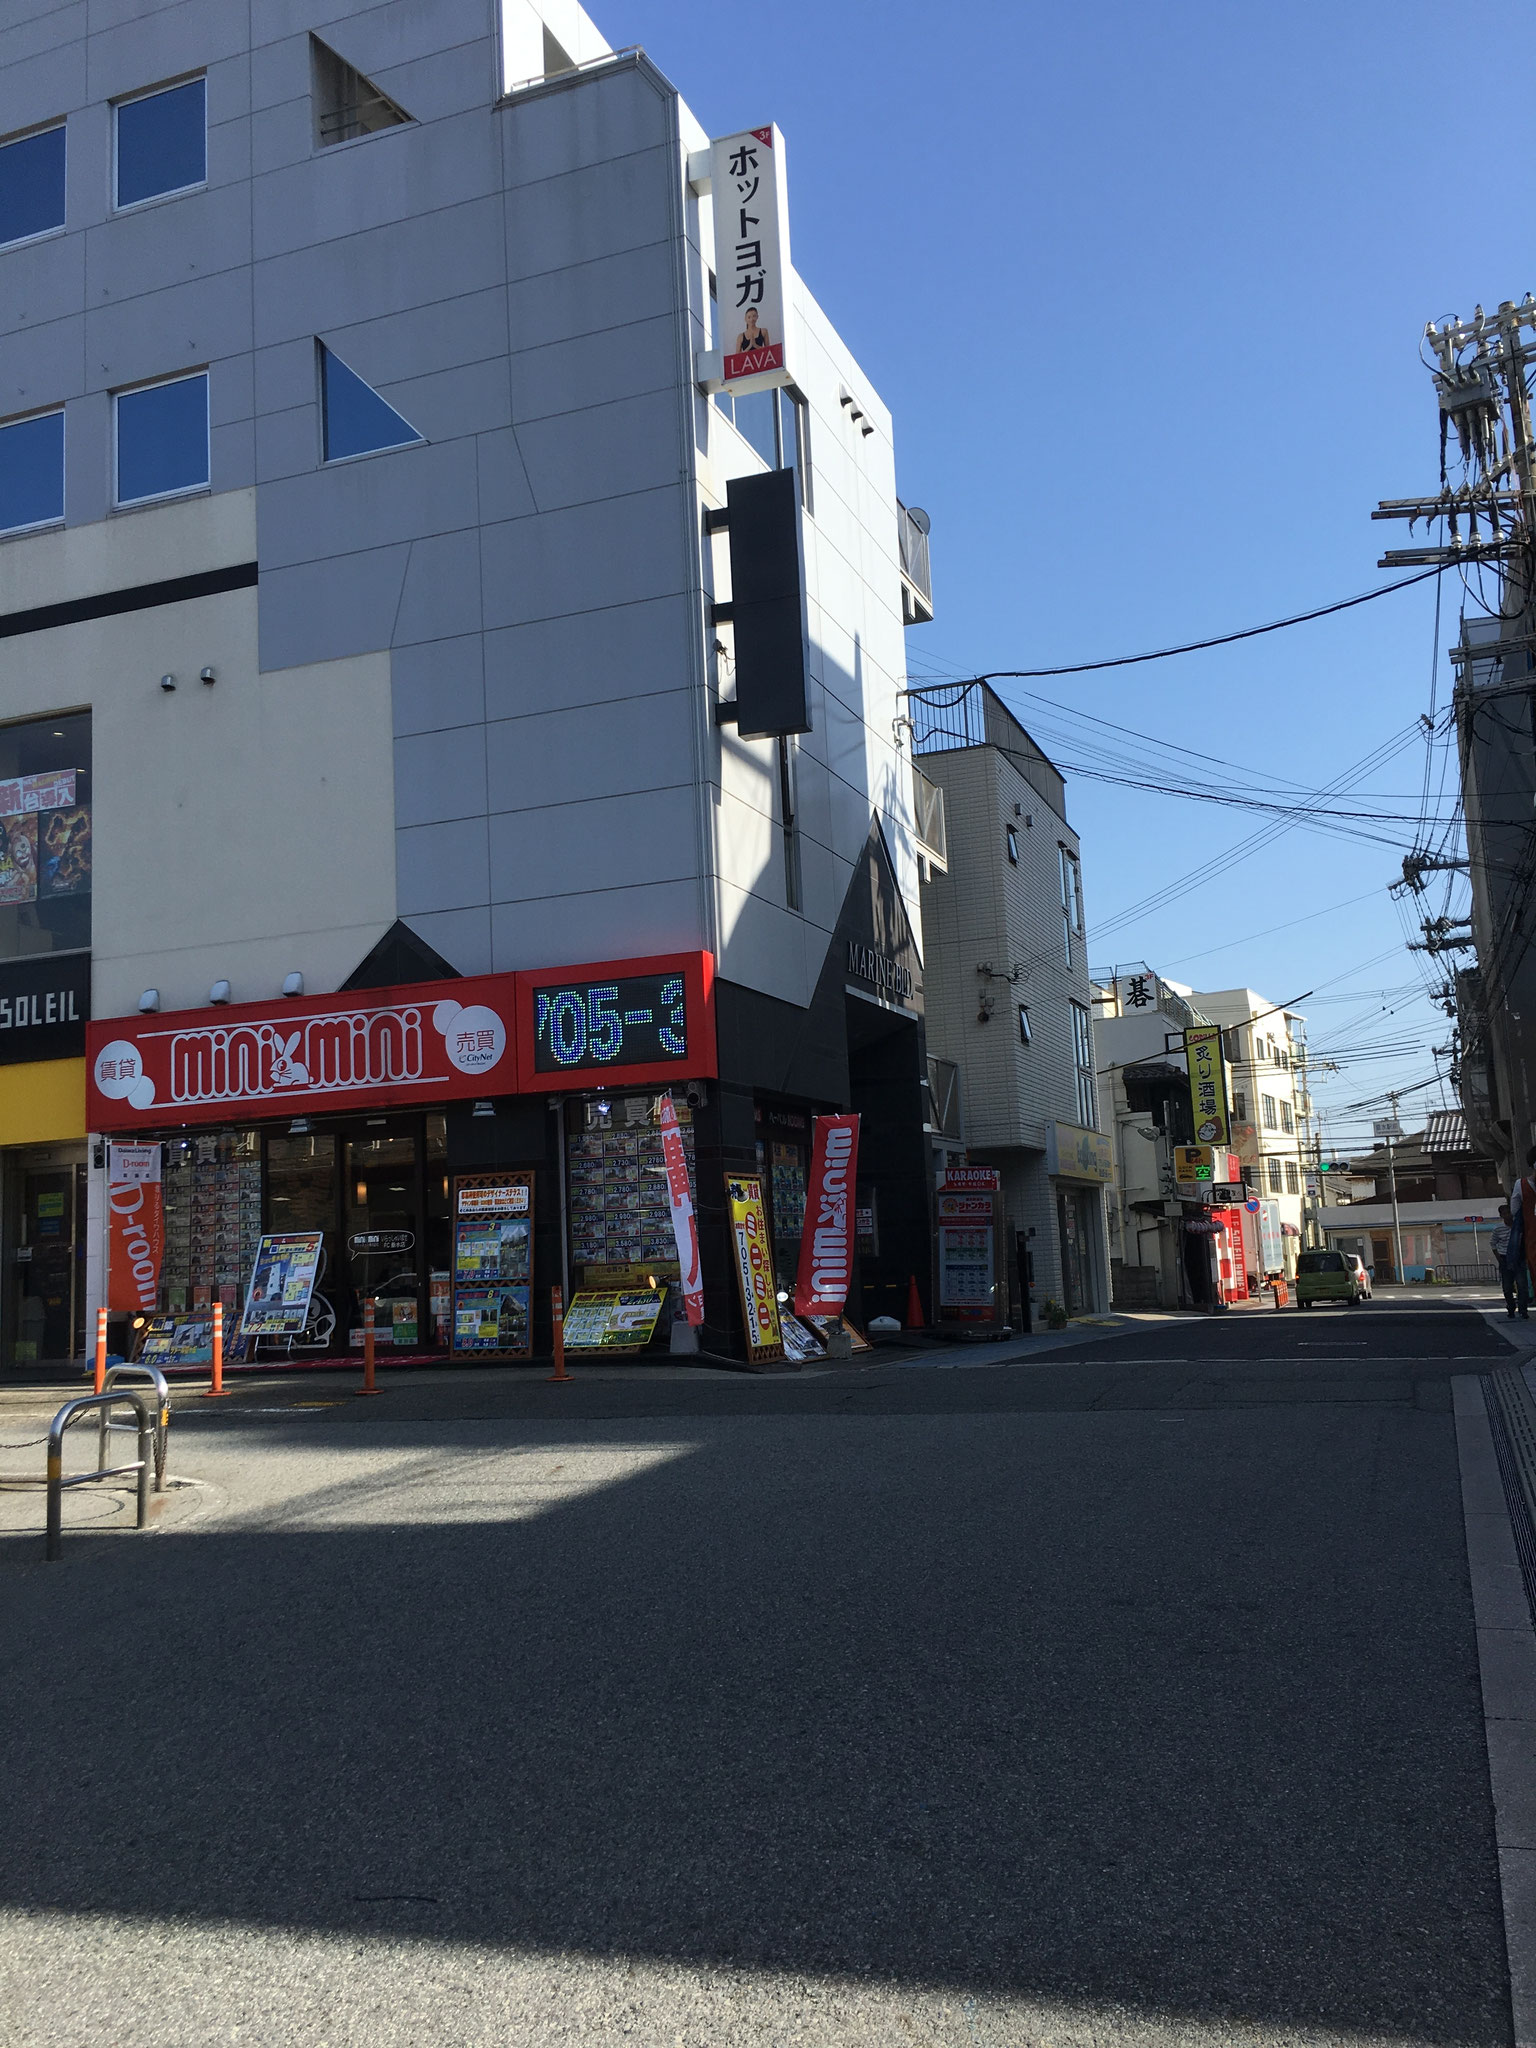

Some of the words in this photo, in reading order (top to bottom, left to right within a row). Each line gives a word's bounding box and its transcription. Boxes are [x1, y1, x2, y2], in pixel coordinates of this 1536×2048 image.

[760, 130, 770, 140] 3F
[729, 145, 767, 308] ホットヨガ
[731, 350, 777, 375] LAVA
[848, 941, 892, 990] MARINE
[1125, 976, 1154, 1008] 碁
[0, 990, 79, 1029] SOLEIL
[457, 1030, 494, 1053] 売買
[171, 1025, 275, 1102] mini
[305, 1008, 423, 1089] mini
[467, 1054, 492, 1062] CityNet
[100, 1059, 136, 1081] 賃貸
[1195, 1045, 1217, 1115] 炙り酒場
[123, 1159, 149, 1169] D-room
[1185, 1148, 1201, 1163] P
[947, 1170, 992, 1181] KARAOKE
[1195, 1165, 1211, 1180] 空
[959, 1201, 991, 1210] ジャンカラ
[756, 1204, 774, 1300] お住まい探しは
[746, 1213, 770, 1330] ミニミニ
